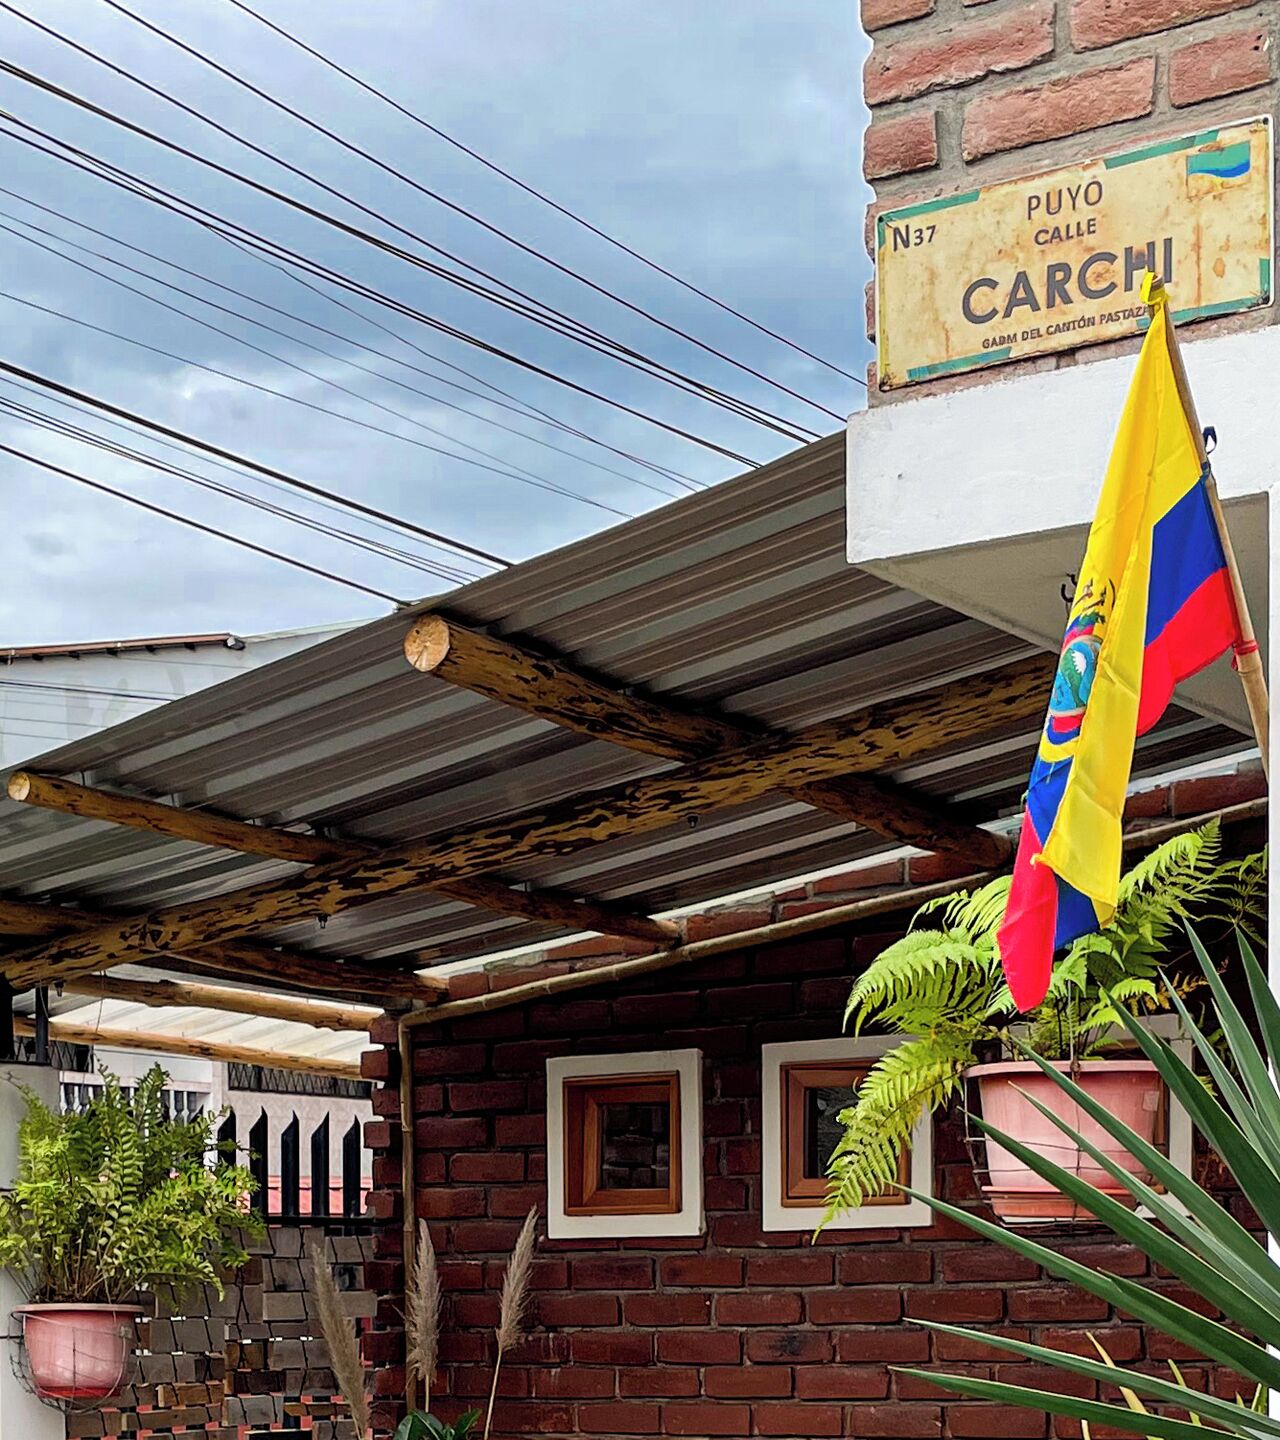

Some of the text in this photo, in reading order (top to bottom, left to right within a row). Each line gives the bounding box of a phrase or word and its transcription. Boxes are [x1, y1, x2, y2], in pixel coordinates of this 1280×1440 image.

[1027, 180, 1103, 220] PUYO
[893, 224, 936, 252] N37
[1034, 218, 1097, 245] CALLE
[962, 236, 1173, 325] CARCHI
[982, 333, 1017, 349] GADM
[1021, 327, 1043, 341] DEL
[1046, 315, 1096, 335] CANTÓN
